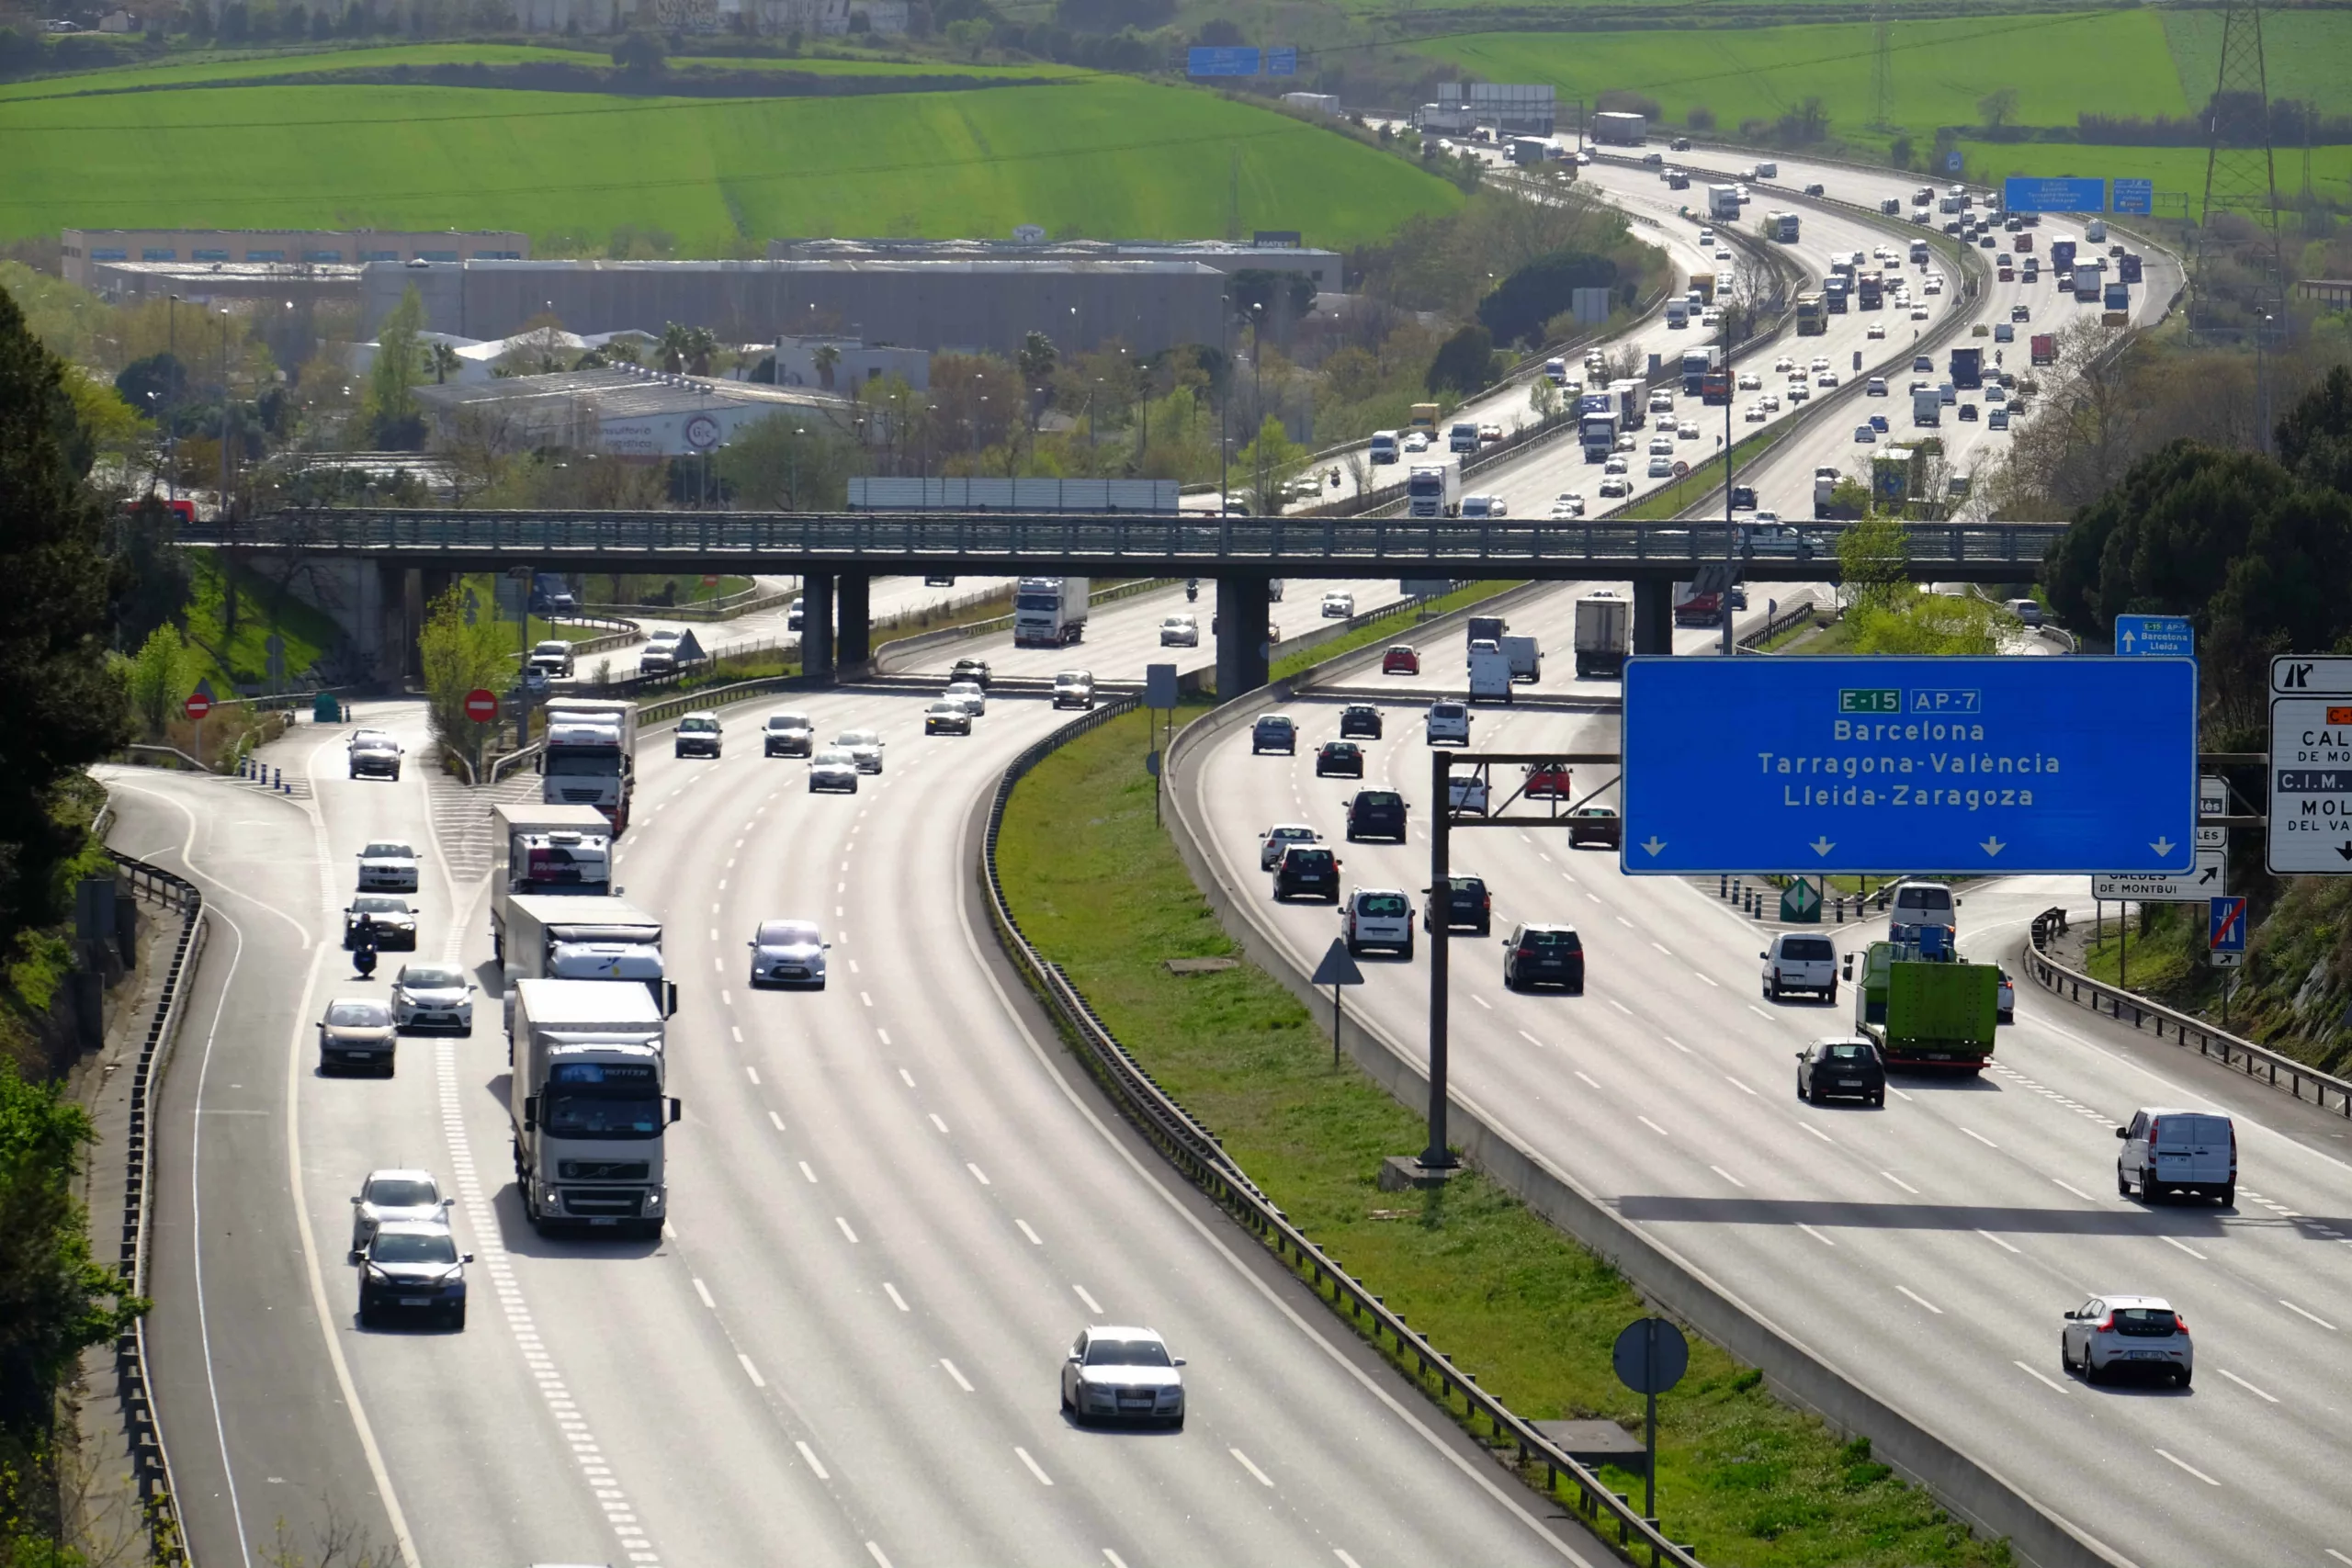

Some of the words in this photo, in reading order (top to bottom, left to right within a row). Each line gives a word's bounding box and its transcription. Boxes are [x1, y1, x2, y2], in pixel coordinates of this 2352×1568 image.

[2141, 632, 2188, 641] Barcelona
[2150, 642, 2178, 650] Lleida
[1842, 692, 1897, 710] E-15
[1916, 693, 1975, 709] AP-7
[1834, 719, 1984, 741] Barcelona
[2298, 751, 2319, 761] DE
[1758, 752, 2060, 779] Tarragona-València
[2281, 773, 2344, 789] C.I.M.
[1784, 784, 2033, 811] Lleida-Zaragoza
[2288, 820, 2320, 831] DEL
[2099, 884, 2115, 893] DE
[2121, 884, 2177, 894] MONTBUI
